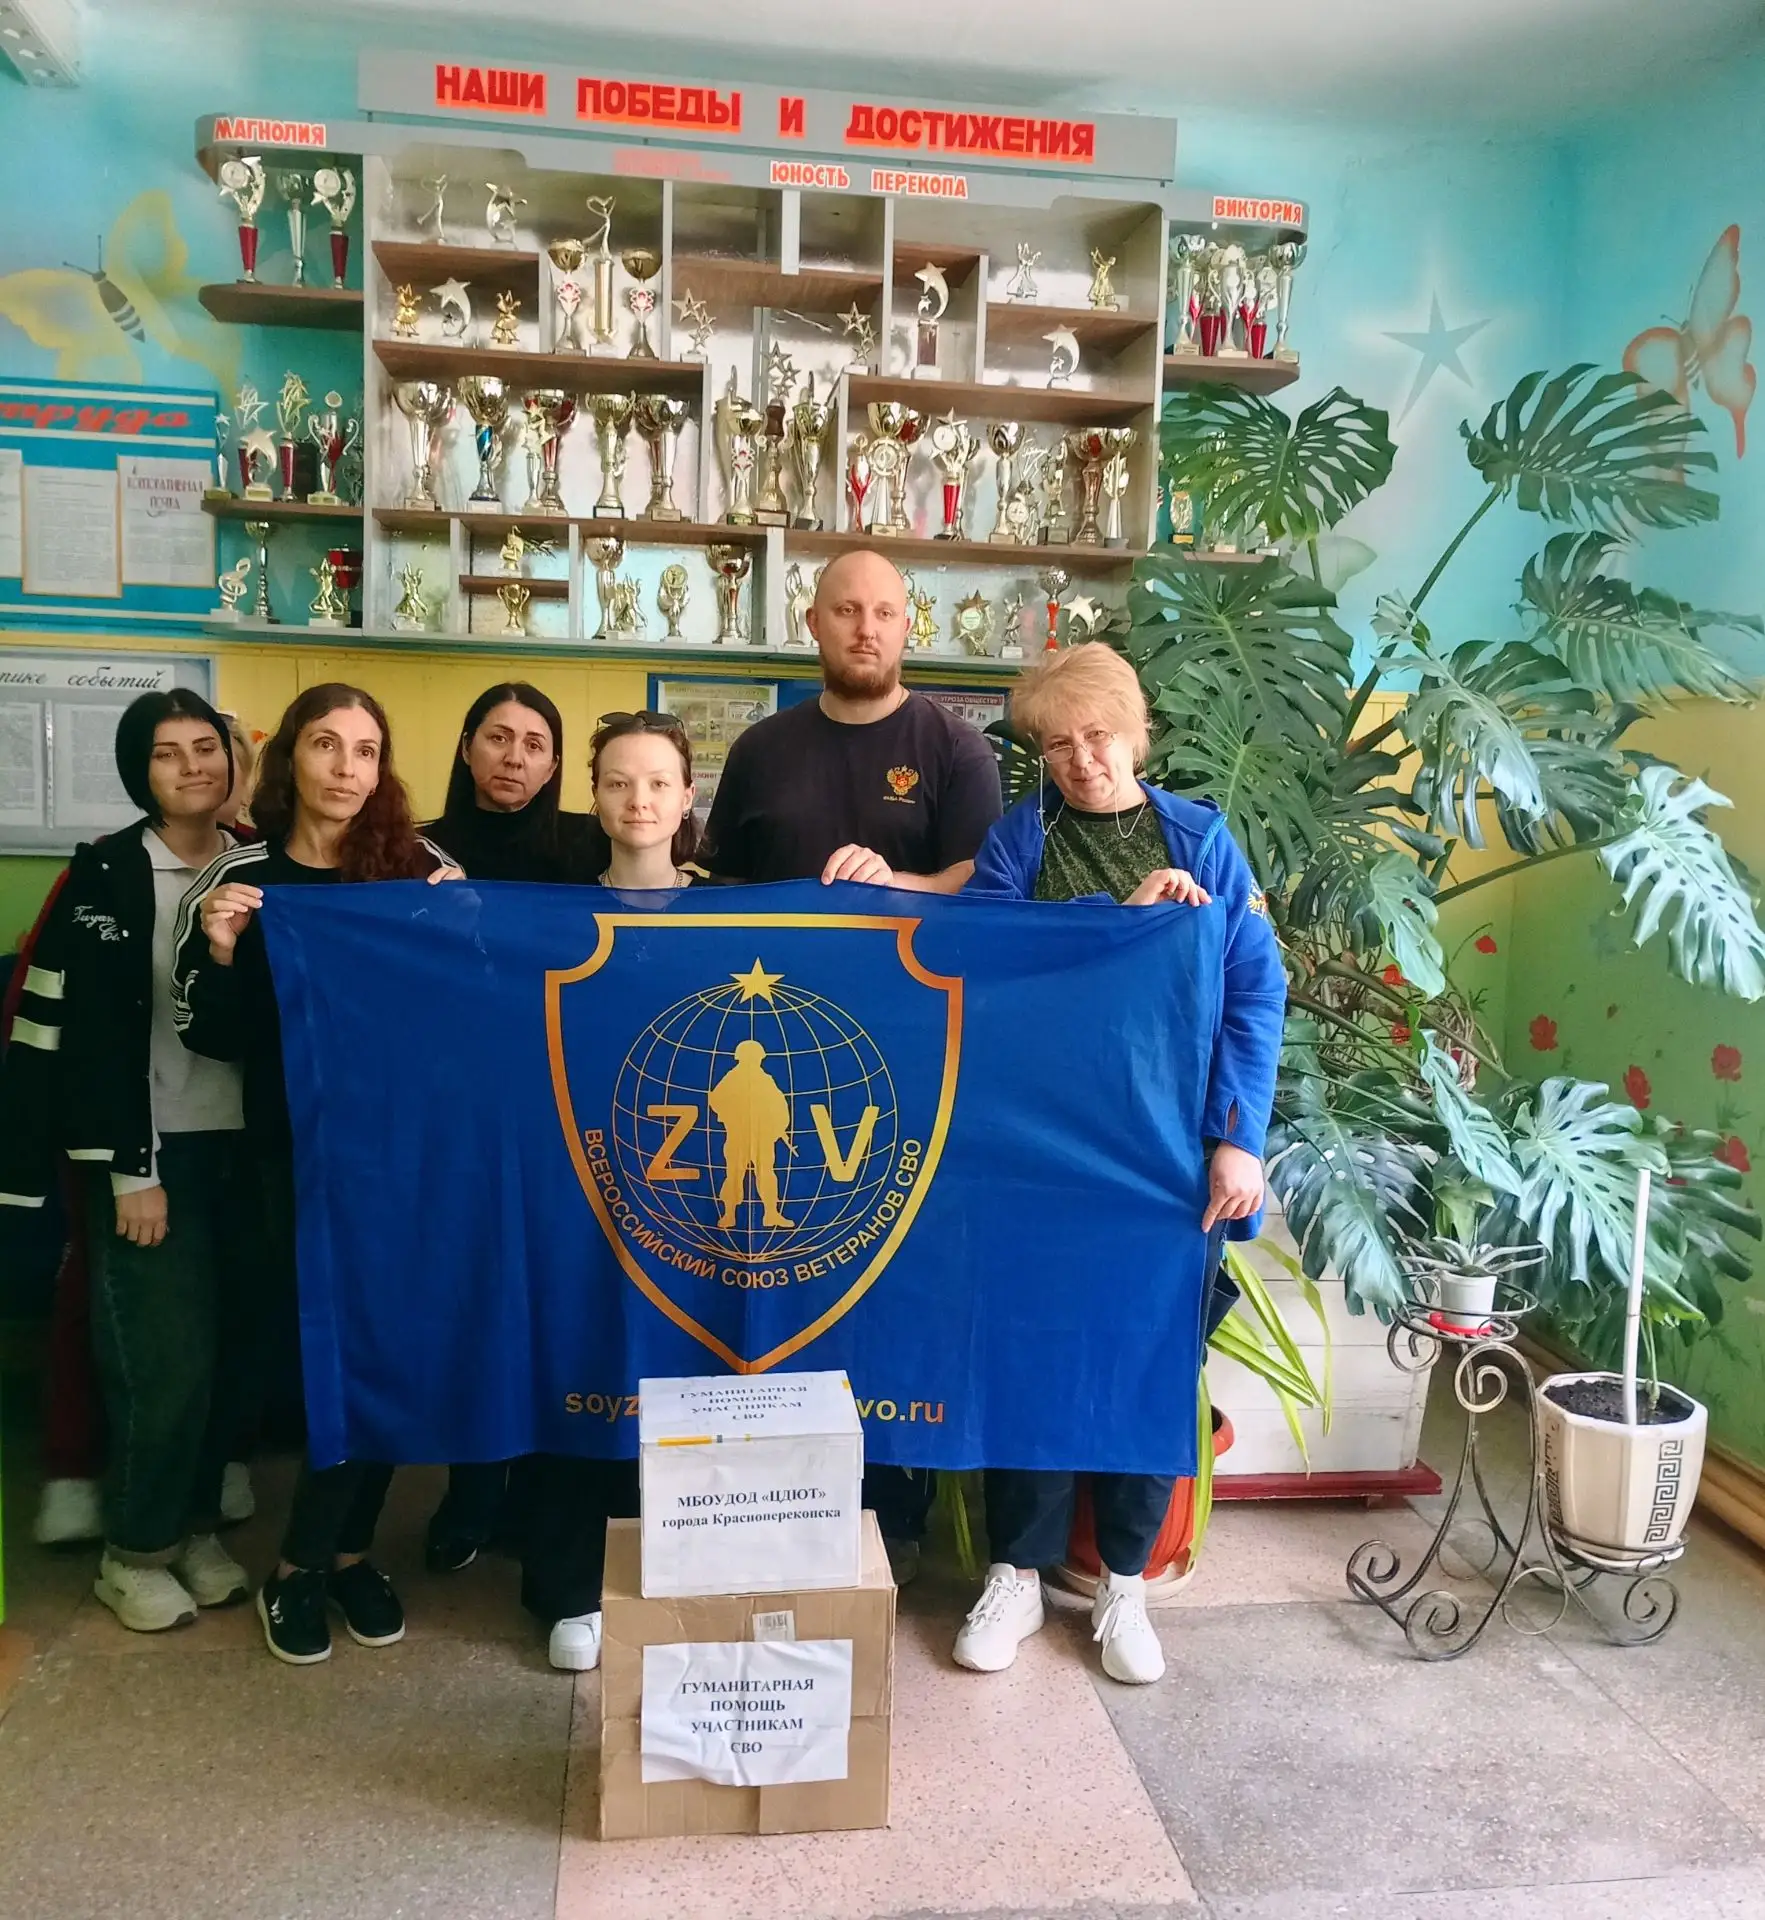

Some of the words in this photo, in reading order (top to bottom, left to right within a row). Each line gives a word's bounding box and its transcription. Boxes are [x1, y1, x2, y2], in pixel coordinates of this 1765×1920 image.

[435, 64, 546, 115] НАШИ
[576, 77, 742, 133] ПОБЕДЫ
[778, 96, 806, 138] И
[844, 103, 1095, 163] ДОСТИЖЕНИЯ
[214, 116, 327, 147] МАГНОЛИЯ
[770, 161, 849, 189] ЮНОСТЬ
[871, 169, 968, 199] ПЕРЕКОПА
[1213, 196, 1303, 224] ВИКТОРИЯ
[67, 666, 166, 689] событий
[646, 1104, 700, 1181] Z
[810, 1104, 880, 1182] V
[584, 1128, 717, 1280] ВСЕРОССИЙСКИЙ
[721, 1267, 789, 1289] СОЮЗ
[793, 1189, 905, 1283] ВЕТЕРАНОВ
[894, 1138, 922, 1187] СВО
[680, 1386, 808, 1399] ГУМАНИТАРНАЯ
[709, 1395, 782, 1404] ПОМОЩЬ
[691, 1402, 802, 1414] УЧАСТНИКАМ
[732, 1413, 765, 1421] СВО
[677, 1492, 758, 1508] МБОУДОД
[762, 1487, 826, 1504] «ЦДЮТ»
[662, 1517, 709, 1530] города
[712, 1508, 841, 1527] Красноперекопска
[681, 1678, 815, 1695] ГУМАНИТАРНАЯ
[710, 1699, 786, 1713] ПОМОЩЬ
[691, 1718, 803, 1734] УЧАСТНИКАМ
[730, 1742, 763, 1754] СВО
